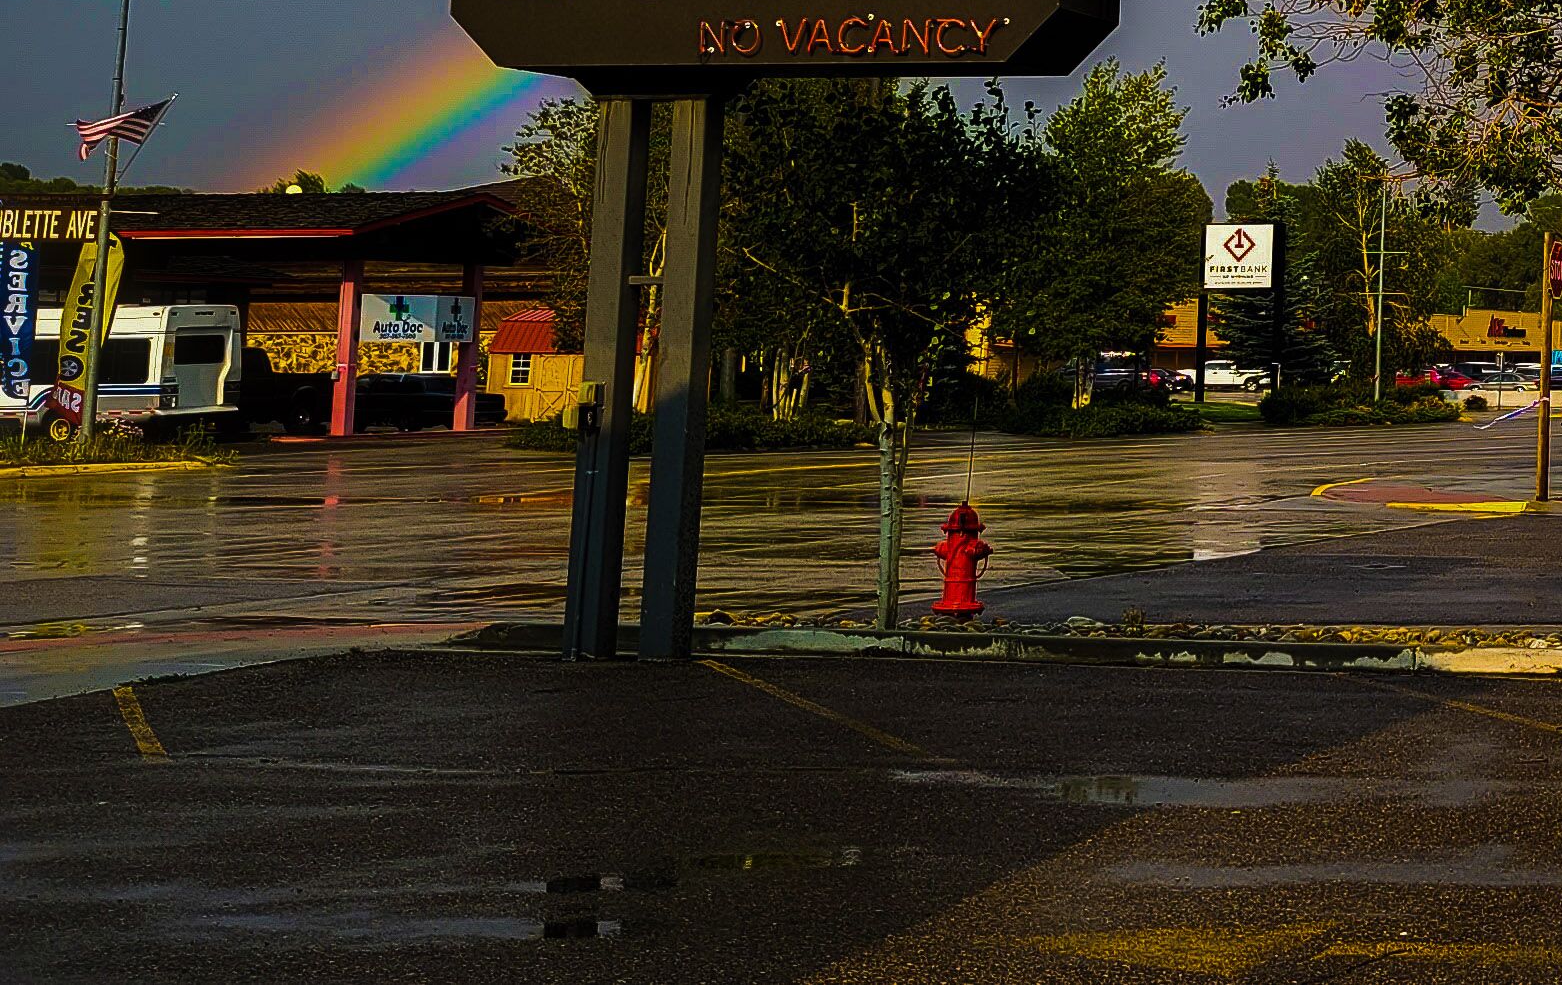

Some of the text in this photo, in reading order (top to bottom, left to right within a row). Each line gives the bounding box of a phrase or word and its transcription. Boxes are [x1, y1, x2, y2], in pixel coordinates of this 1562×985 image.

[700, 17, 998, 54] NO VACANCY
[0, 210, 98, 239] BLETTE AVE
[372, 320, 424, 334] Auto Doc
